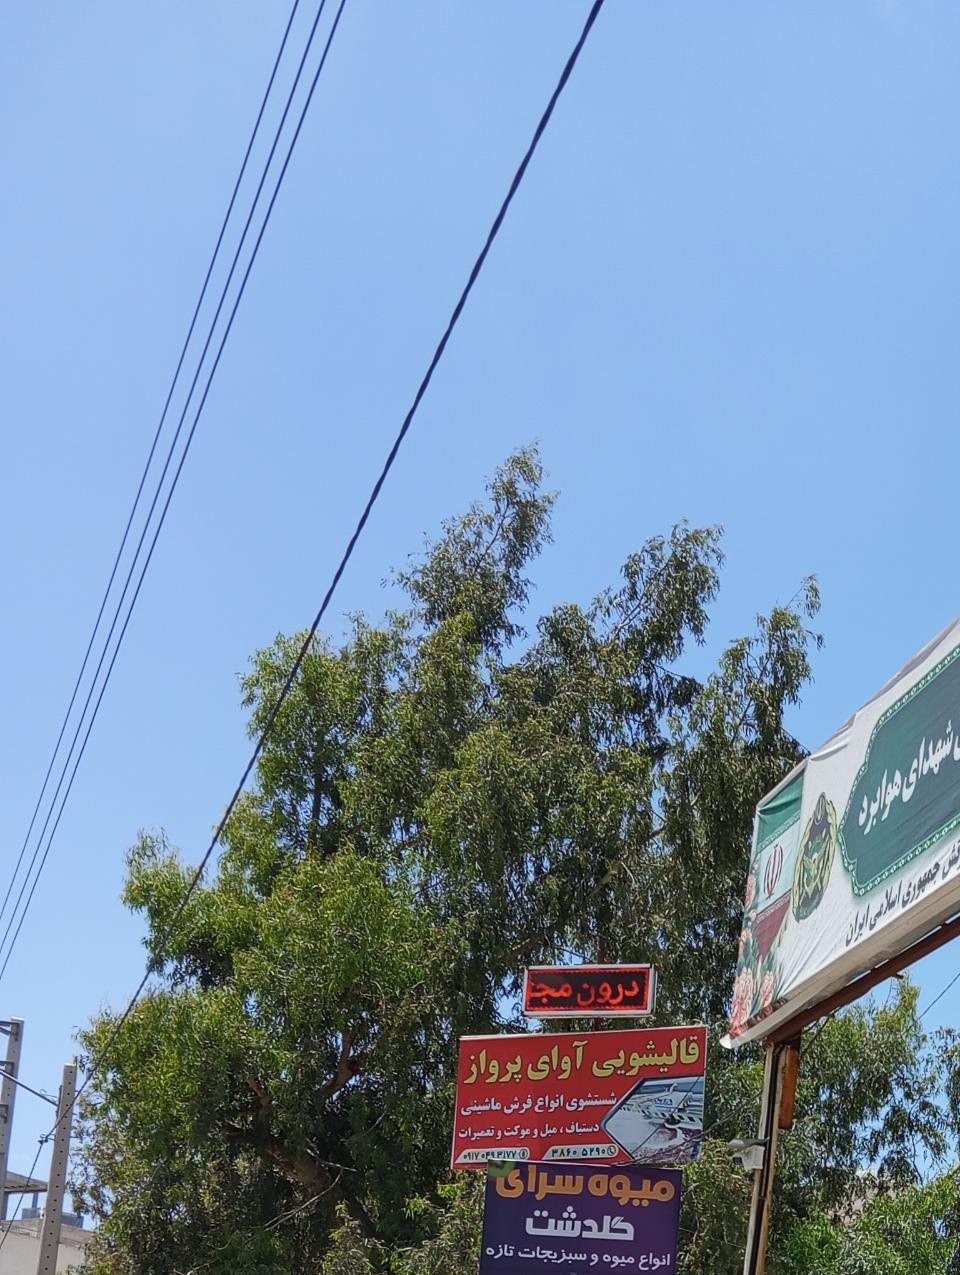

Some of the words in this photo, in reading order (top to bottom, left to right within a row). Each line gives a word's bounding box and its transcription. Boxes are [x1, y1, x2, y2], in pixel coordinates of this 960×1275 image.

[901, 719, 954, 803] شهدای
[858, 768, 902, 836] هوابرد
[901, 861, 941, 908] جمهوری
[869, 880, 903, 931] اسلامی
[845, 903, 871, 947] ایران
[527, 1040, 588, 1080] آوای
[592, 1036, 700, 1076] قالیشویی
[463, 1049, 522, 1083] پرواز
[461, 1097, 501, 1116] ماشینی
[503, 1095, 532, 1114] فرش
[535, 1094, 563, 1113] انواع
[566, 1091, 617, 1112] شستشوی
[458, 1126, 495, 1141] تعمیرات
[496, 1130, 502, 1139] و
[504, 1125, 531, 1139] موکت
[533, 1128, 538, 1138] و
[540, 1124, 557, 1138] مبل
[496, 1164, 584, 1201] سرای
[588, 1173, 675, 1207] میوه
[525, 1205, 635, 1241] گلدشت
[486, 1244, 515, 1259] تازه
[518, 1246, 587, 1264] سبزیجات
[590, 1253, 599, 1265] و
[602, 1253, 635, 1268] میوه
[638, 1253, 671, 1270] انواع
